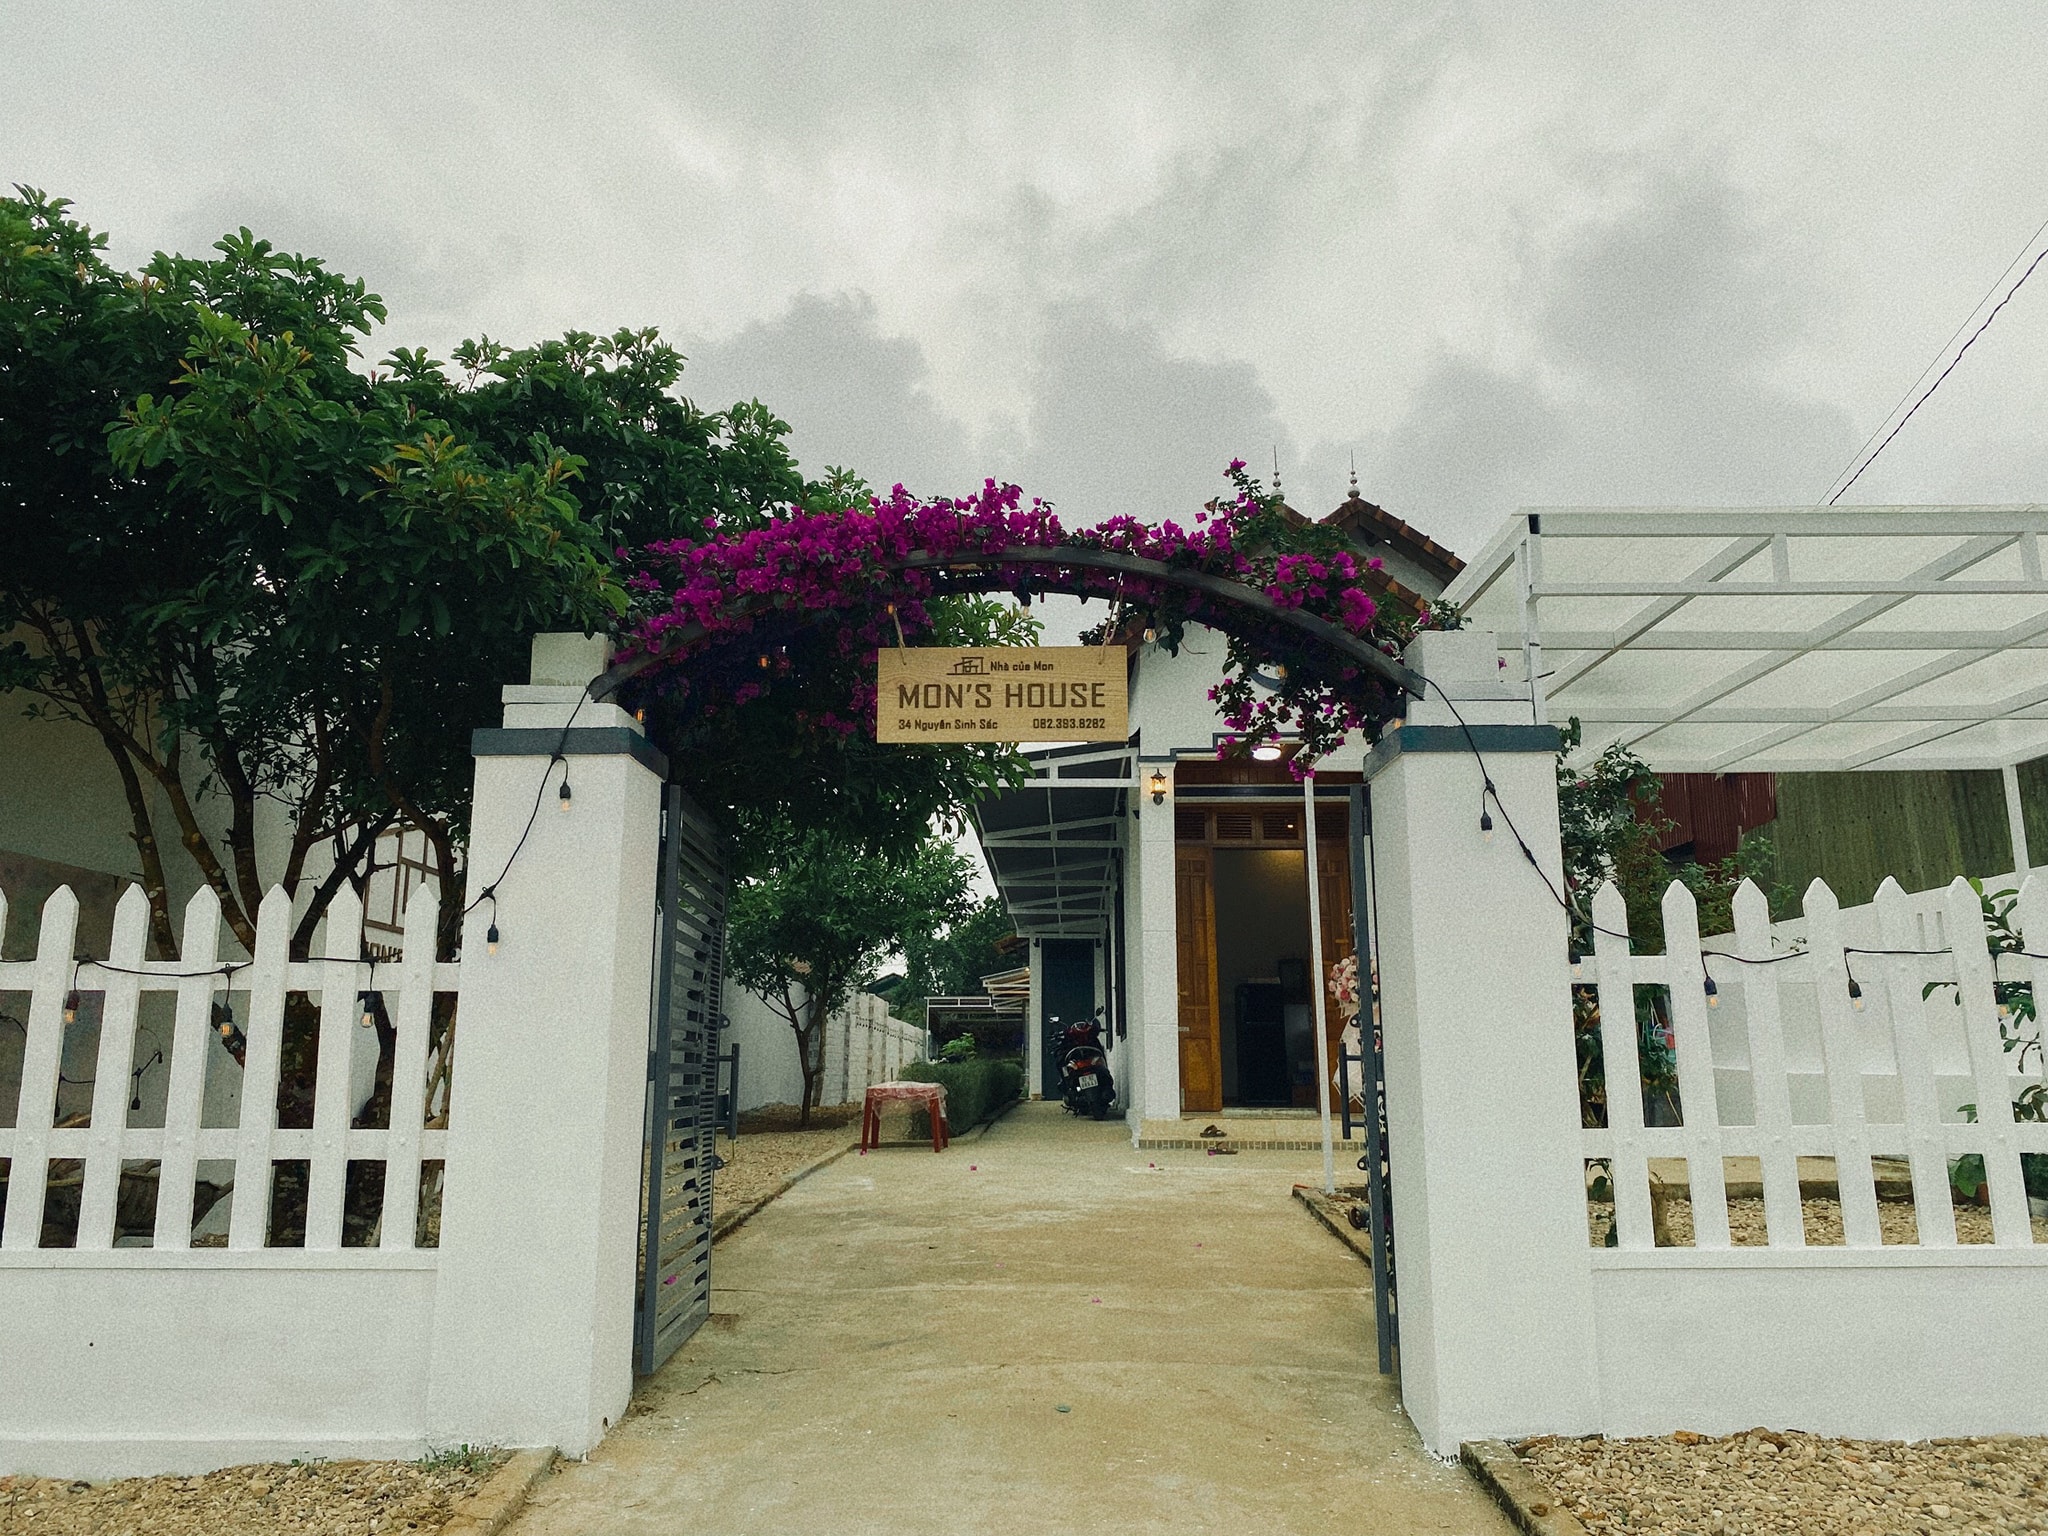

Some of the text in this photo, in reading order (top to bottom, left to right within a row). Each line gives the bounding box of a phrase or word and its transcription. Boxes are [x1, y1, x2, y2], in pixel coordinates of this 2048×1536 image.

[990, 660, 1054, 672] Nhà của Mon
[899, 682, 1106, 709] MON'S HOUSE
[898, 718, 912, 730] 34
[954, 718, 977, 730] Sinh
[1033, 718, 1106, 729] 082.393.8282
